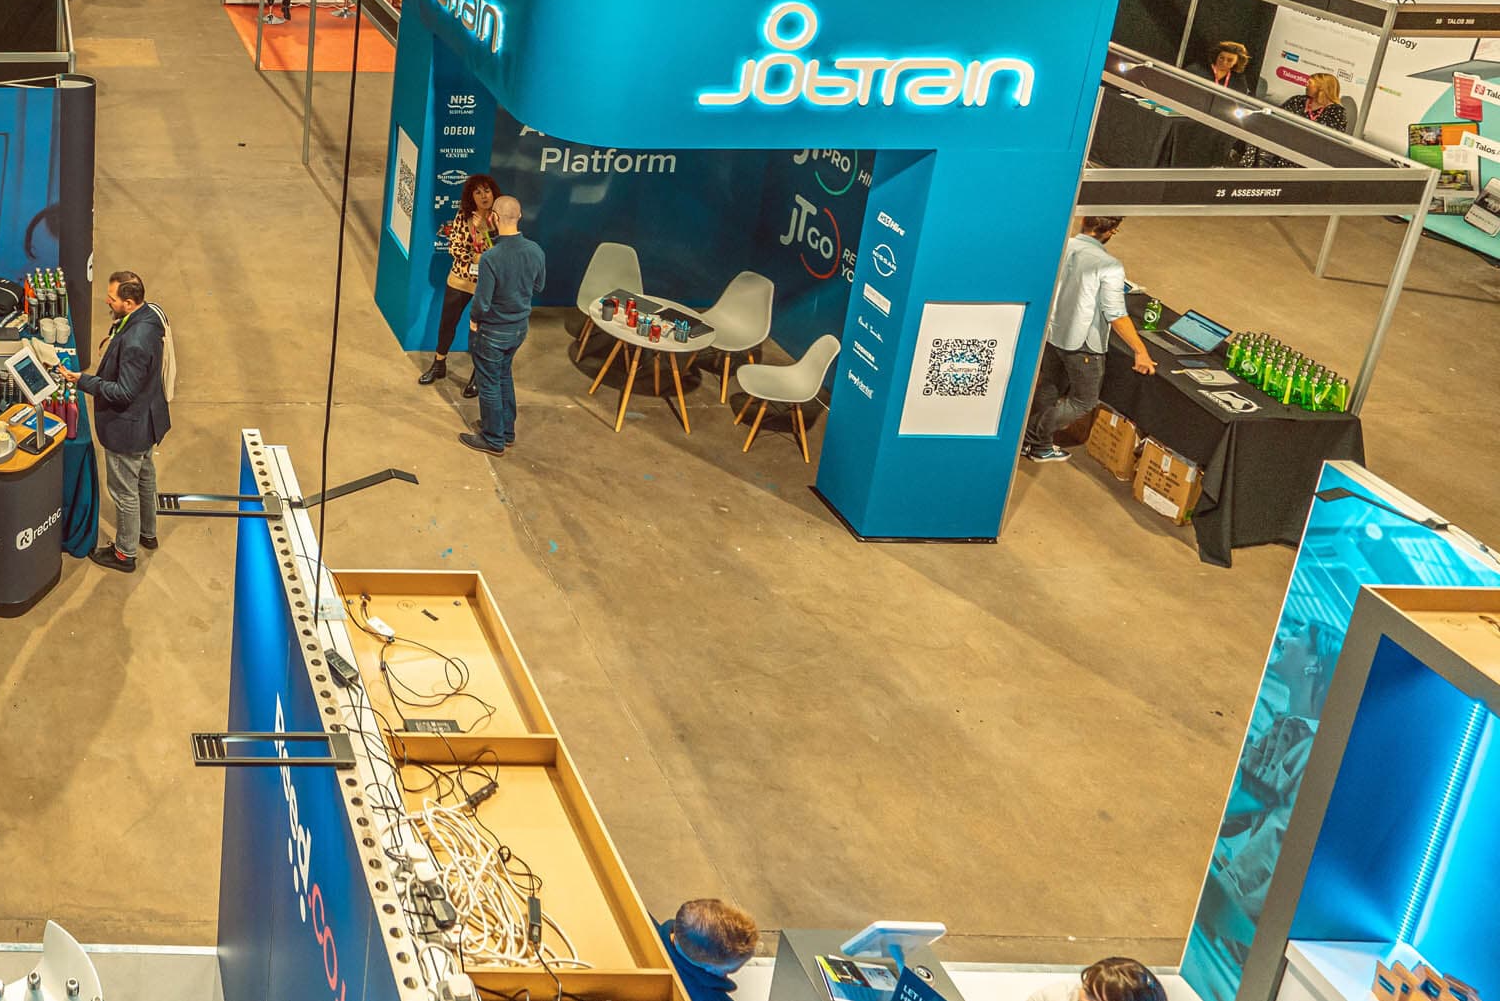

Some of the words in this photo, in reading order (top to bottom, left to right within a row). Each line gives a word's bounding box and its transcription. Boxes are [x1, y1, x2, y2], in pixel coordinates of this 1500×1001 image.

[450, 95, 475, 104] NHS
[443, 126, 475, 136] ODEON
[1475, 141, 1496, 155] Talos
[539, 147, 677, 174] Platform
[1216, 189, 1226, 197] 25
[1231, 188, 1282, 197] ASSESSFIRST
[807, 227, 834, 259] GO
[33, 507, 62, 540] rectec
